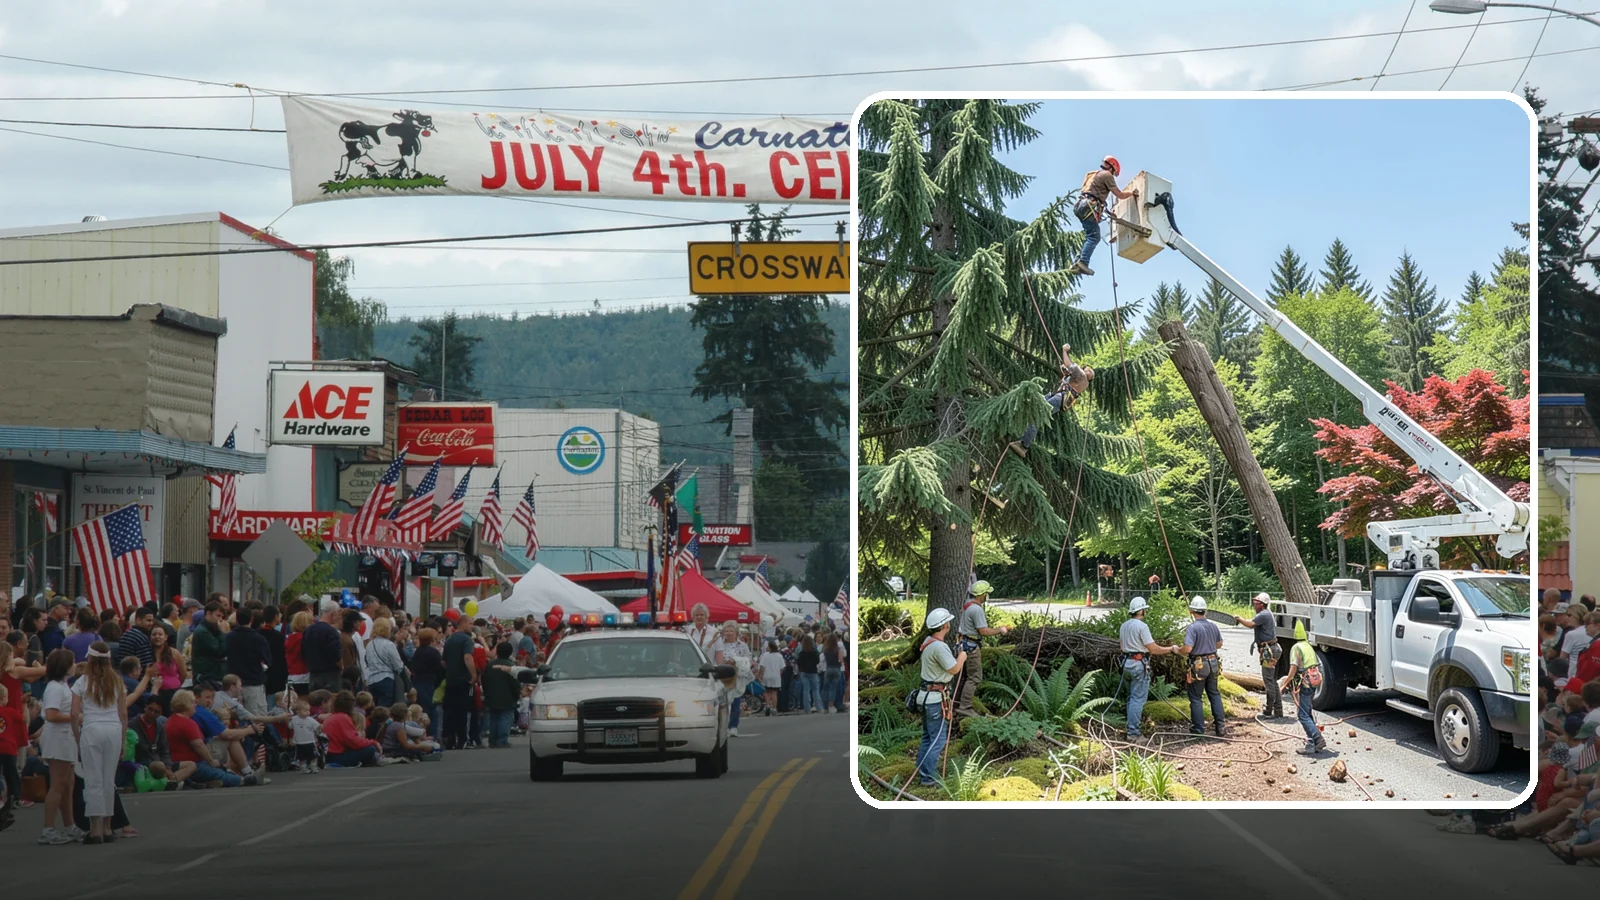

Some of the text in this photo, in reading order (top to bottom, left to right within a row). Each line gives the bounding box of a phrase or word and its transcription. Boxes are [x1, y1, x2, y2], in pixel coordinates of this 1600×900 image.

[695, 121, 850, 149] Carnat
[481, 141, 605, 192] JULY
[632, 150, 746, 197] 4th.
[697, 254, 850, 280] CROSSWA
[283, 380, 373, 419] ACE
[406, 409, 452, 422] CEDAR
[283, 421, 371, 436] Hardware
[416, 428, 476, 447] Coca-Cola
[353, 467, 386, 481] Simpl
[95, 485, 124, 495] Vincent
[126, 486, 136, 495] de
[137, 485, 155, 495] Paul
[212, 515, 331, 535] HARDARE
[688, 526, 741, 535] CRNATION
[699, 535, 730, 543] GLASS
